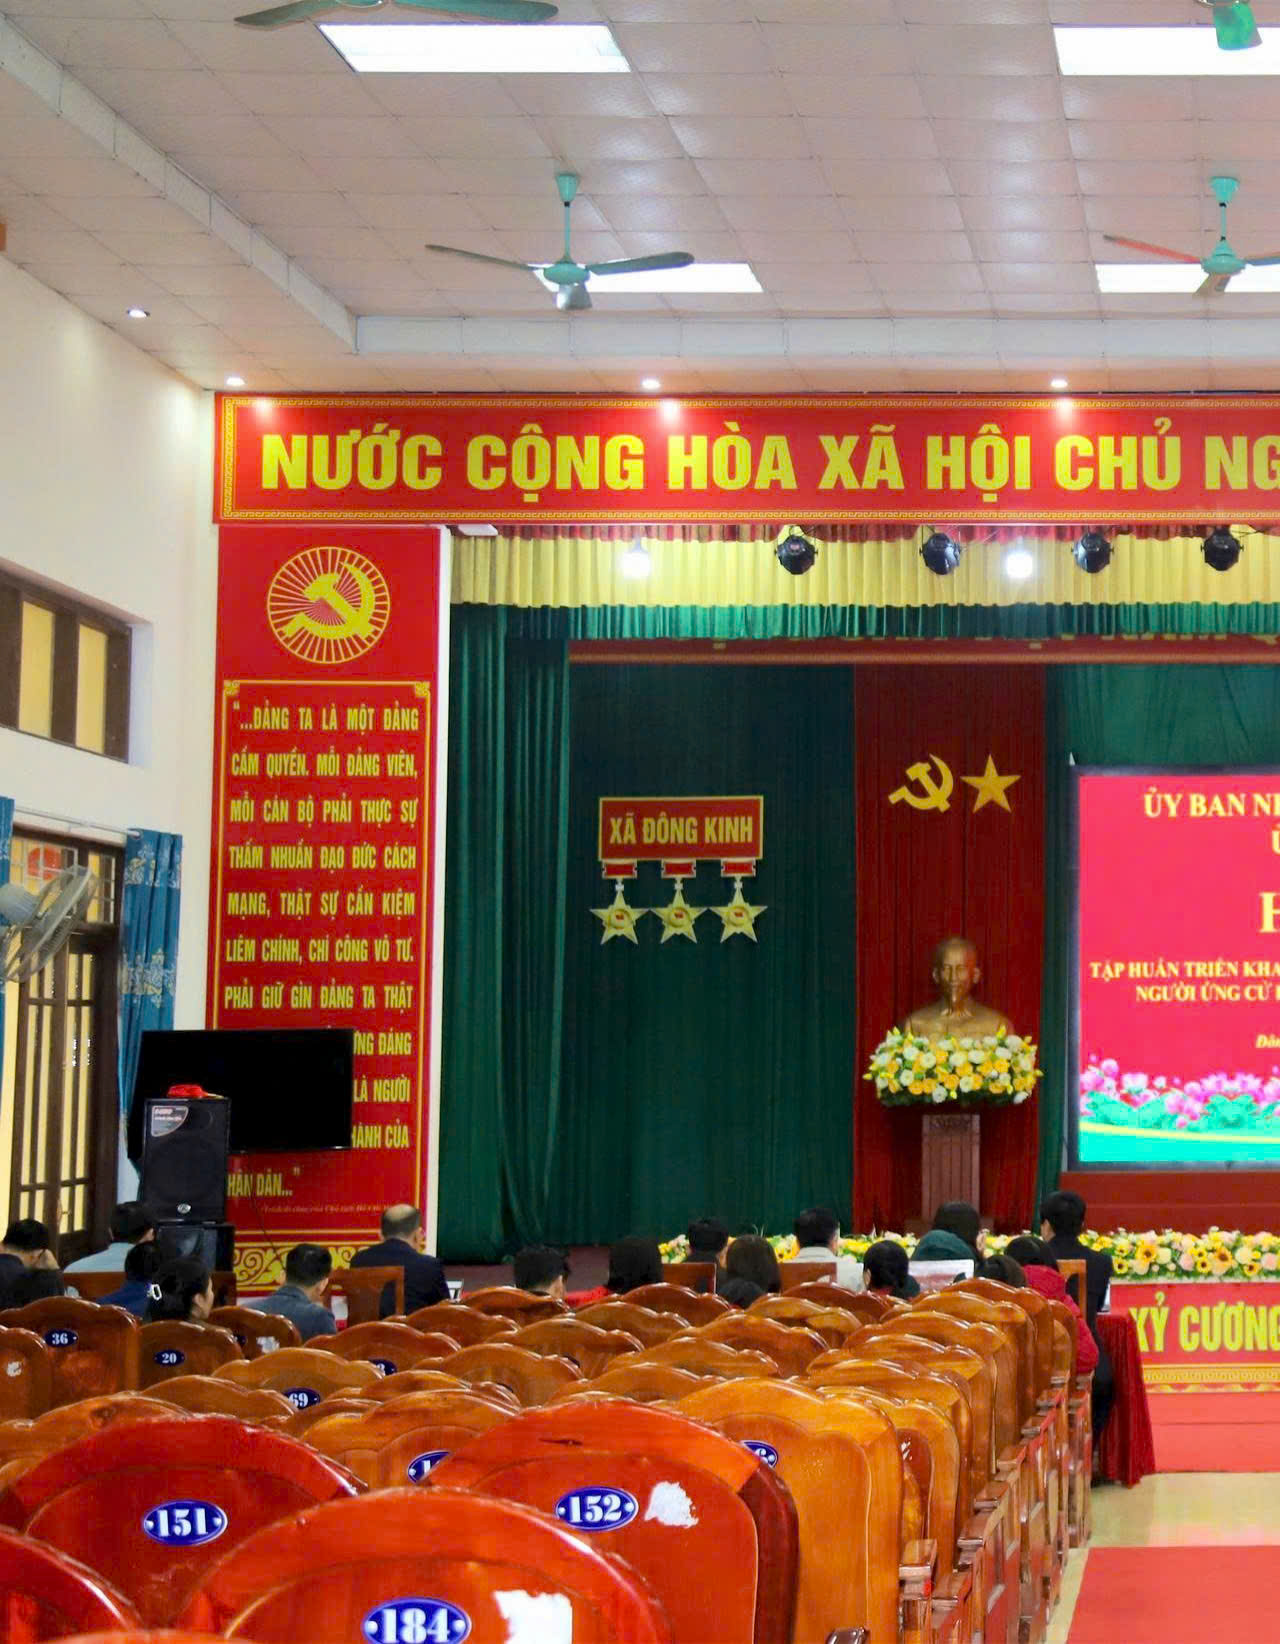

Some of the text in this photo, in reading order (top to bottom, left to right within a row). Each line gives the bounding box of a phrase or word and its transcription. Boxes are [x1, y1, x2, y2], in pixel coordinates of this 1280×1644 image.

[261, 424, 442, 491] NƯỚC
[467, 424, 644, 502] CỘNG
[668, 422, 797, 491] HÒA
[818, 424, 905, 491] XÃ
[926, 424, 1031, 502] HỘI
[1054, 417, 1183, 491] CHỦ
[299, 700, 418, 735] TA LÀ MỘT ĐẢNG
[347, 747, 380, 776] ĐẢNG
[297, 794, 314, 828] BỘ
[361, 799, 391, 828] THỰC
[401, 799, 418, 829] SỰ
[1144, 788, 1183, 817] ỦY
[1190, 793, 1245, 817] BAN
[610, 812, 753, 844] XÃ ĐÔNG KINH
[320, 845, 345, 874] ĐẠO
[352, 842, 376, 868] ĐỨC
[384, 842, 416, 868] CÁCH
[227, 892, 270, 920] MẠNG,
[280, 888, 312, 920] THẬT
[320, 891, 339, 920] SỰ
[382, 888, 415, 920] KIỆM
[226, 935, 255, 962] LIÊM
[335, 935, 368, 961] CÔNG
[375, 935, 389, 961] VÔ
[1090, 960, 1124, 982] TẬP
[1128, 960, 1178, 978] HUẤN
[1184, 959, 1238, 977] TRIỂN
[320, 979, 354, 1008] ĐẢNG
[362, 986, 375, 1008] TA
[384, 980, 413, 1014] THẬT
[1136, 984, 1195, 1001] NGƯỜI
[373, 1074, 410, 1103] NGƯỜI
[385, 1119, 410, 1148] CỦA
[52, 1333, 68, 1345] 36
[162, 1353, 177, 1363] 20
[288, 1393, 309, 1407] 69
[155, 1509, 207, 1537] 151
[569, 1495, 623, 1522] 152
[380, 1608, 450, 1644] 184
